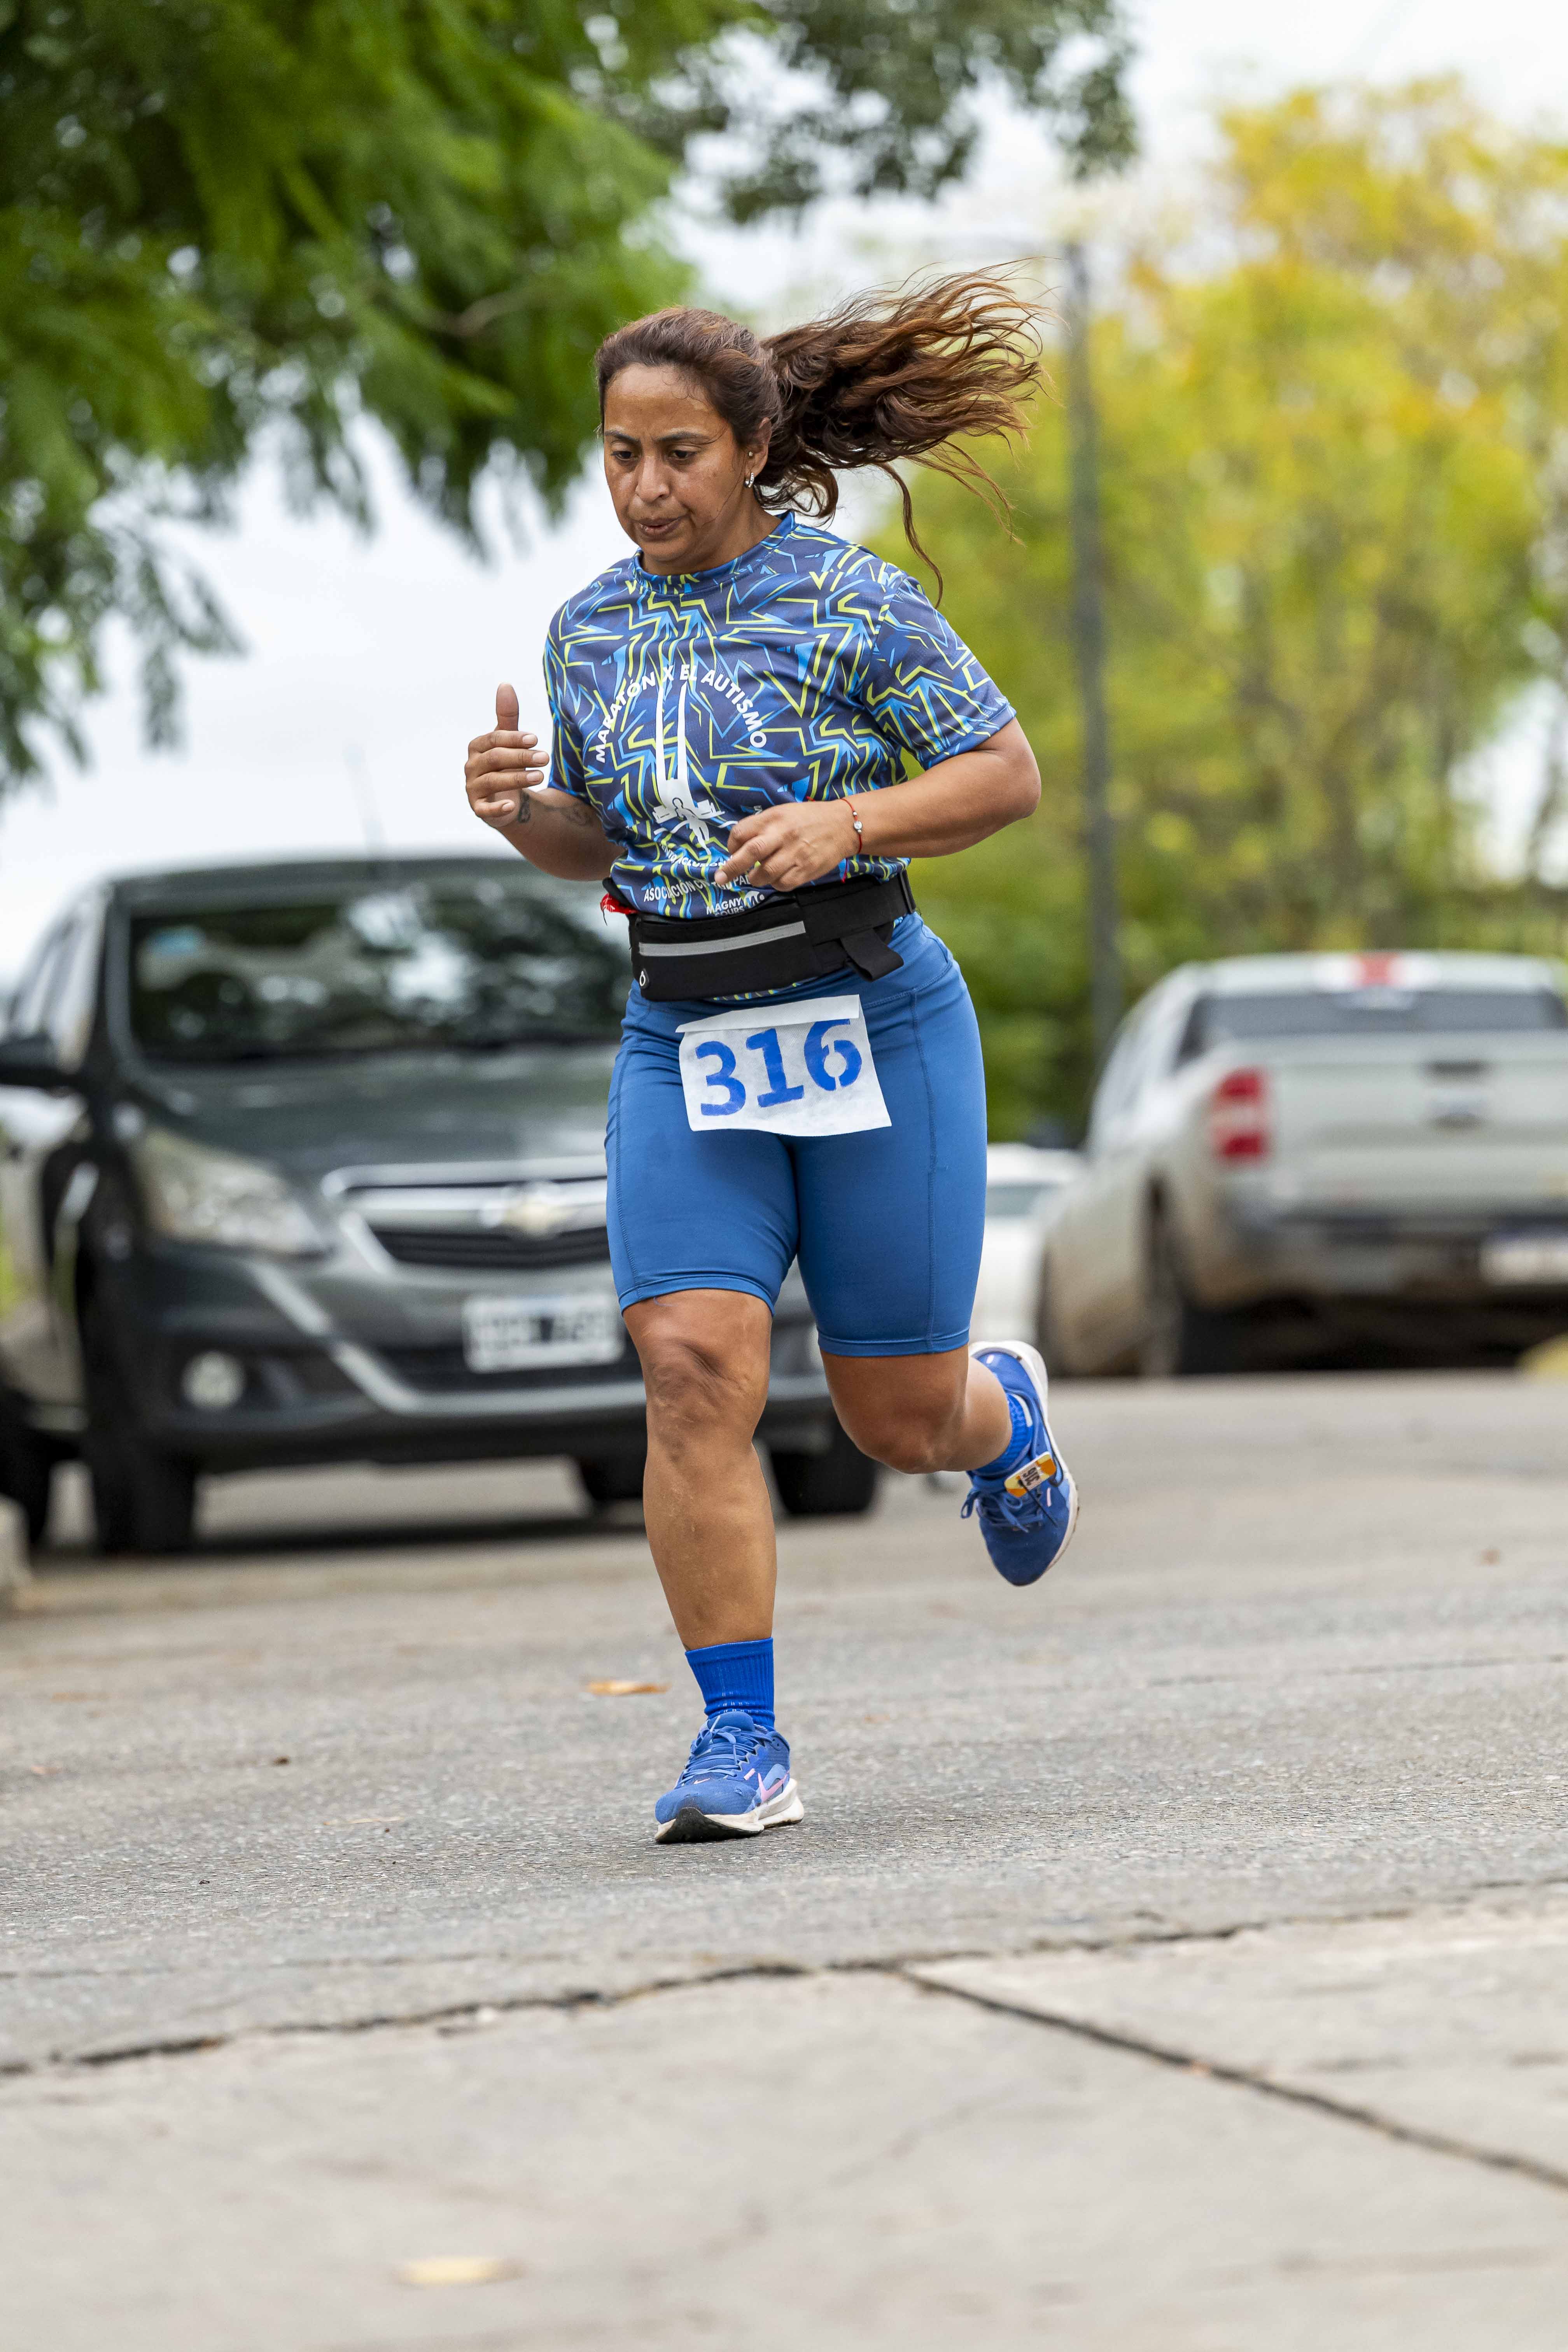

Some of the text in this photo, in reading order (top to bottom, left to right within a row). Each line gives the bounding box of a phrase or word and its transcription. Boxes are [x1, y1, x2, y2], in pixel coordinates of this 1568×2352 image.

[596, 664, 766, 763] MARATÓN X EL AUTISMO
[706, 898, 742, 915] MAGNY
[695, 1018, 862, 1115] 316
